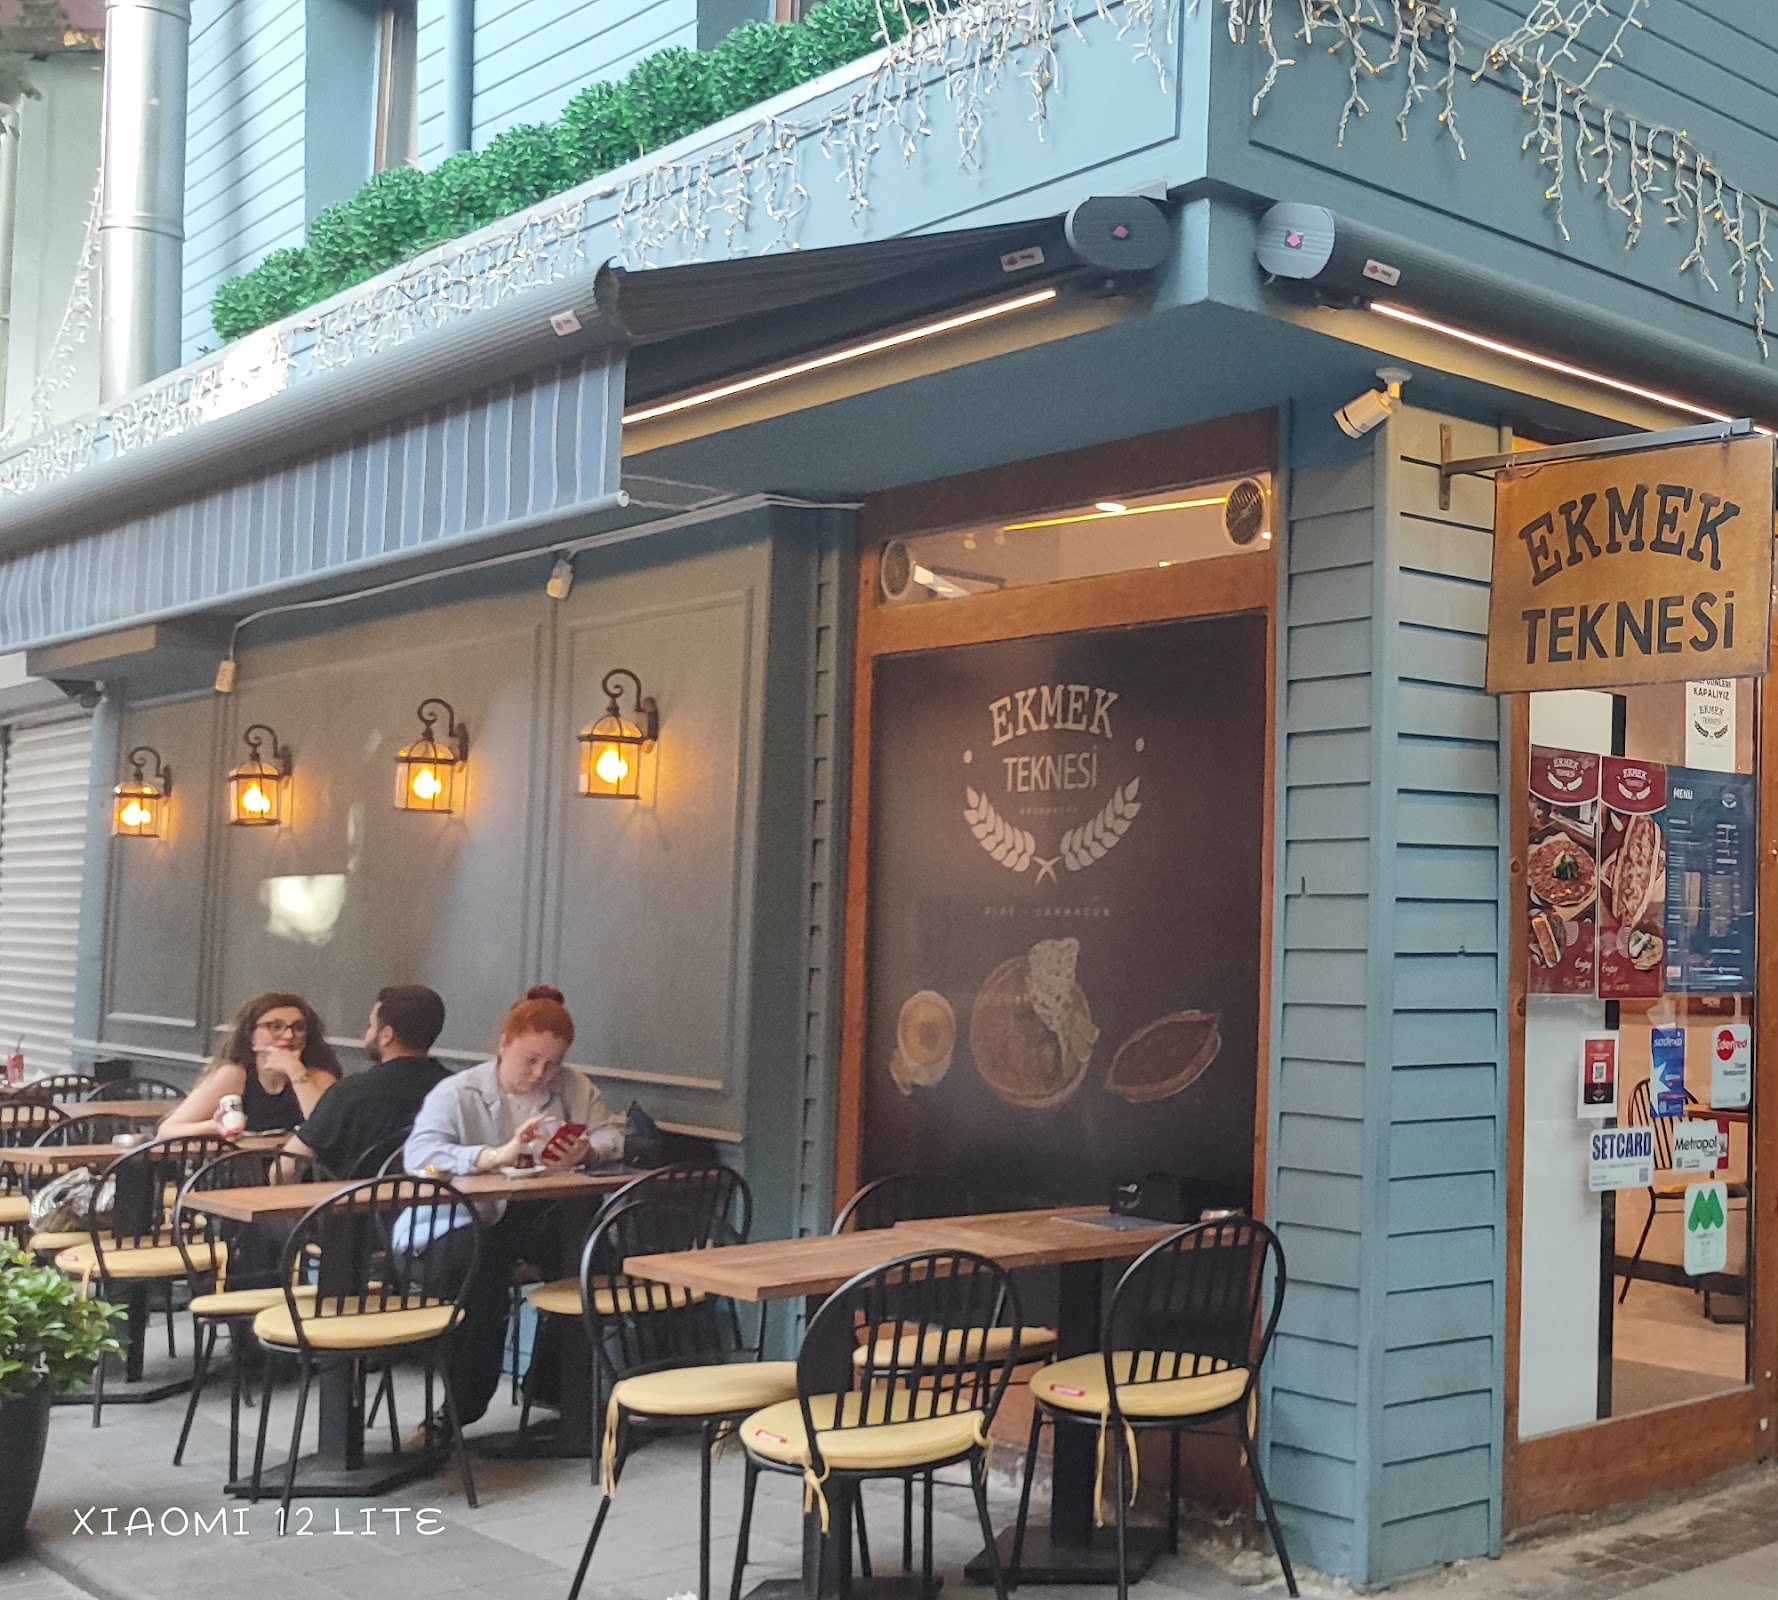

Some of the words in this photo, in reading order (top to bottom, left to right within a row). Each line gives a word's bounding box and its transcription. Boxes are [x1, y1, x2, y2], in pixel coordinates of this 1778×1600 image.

[1518, 483, 1740, 587] EKMEK
[1521, 590, 1735, 664] TEKNESİ
[988, 684, 1119, 746] EKMEK
[1002, 745, 1098, 794] TEKNESİ
[1592, 1131, 1652, 1161] SETCARD
[1674, 1135, 1718, 1153] Metropol
